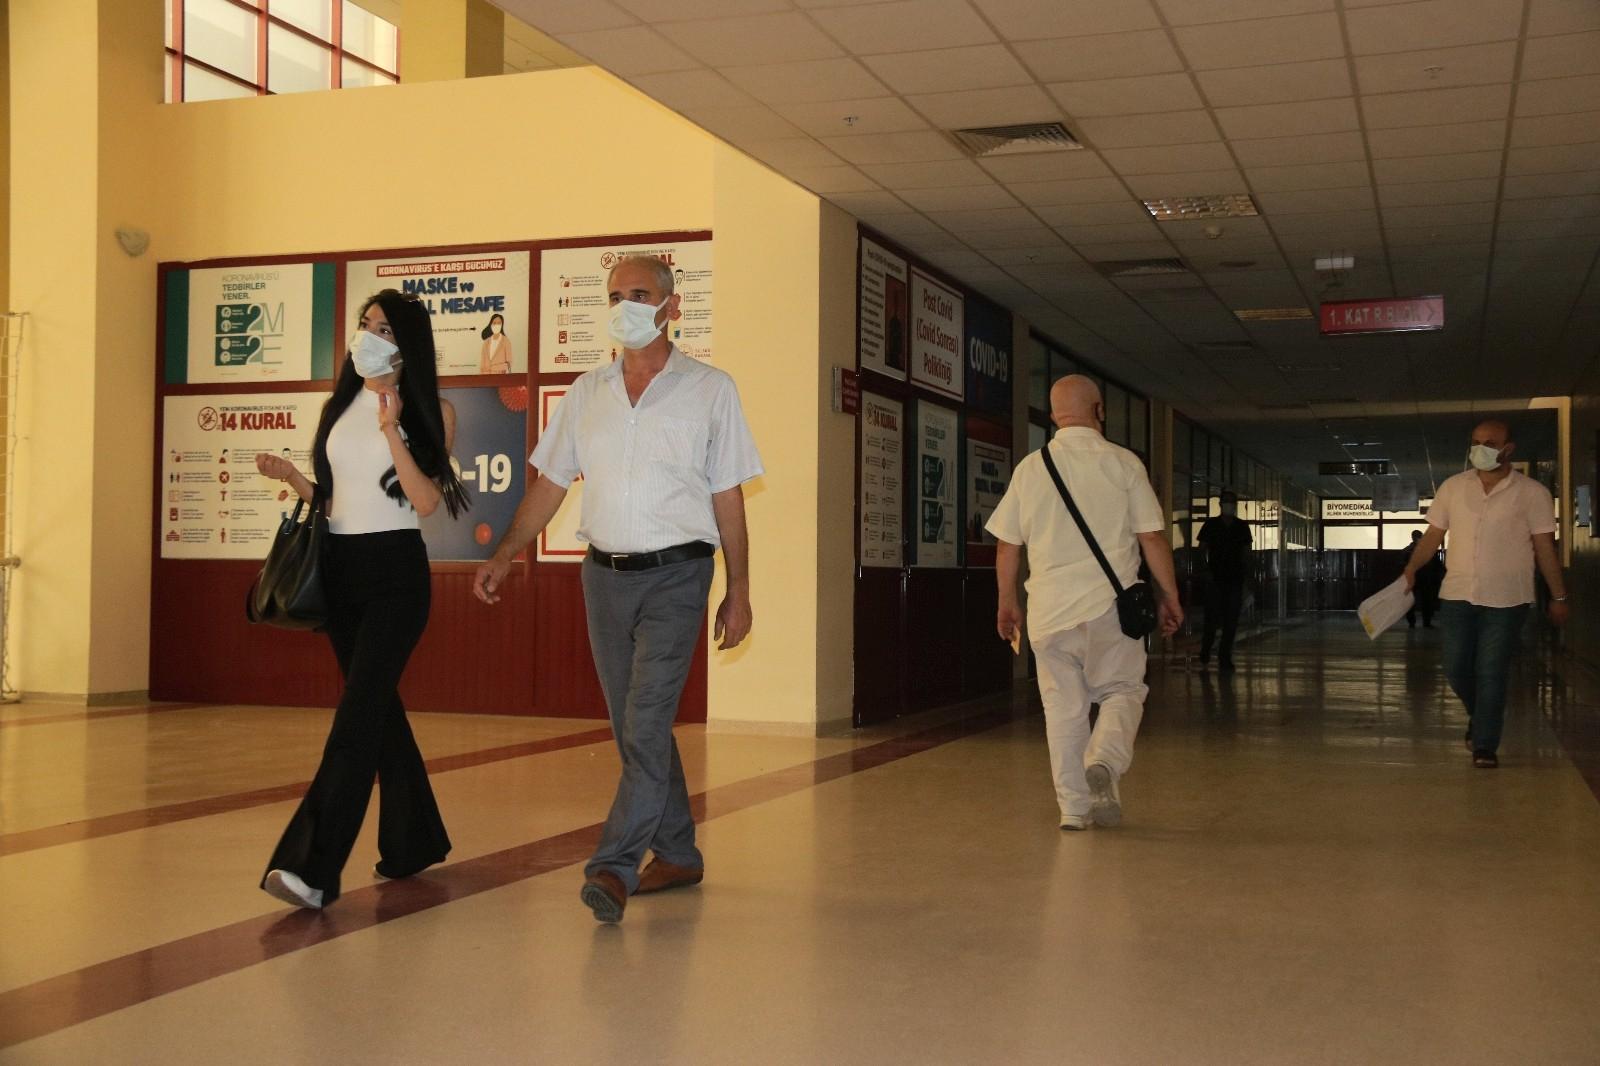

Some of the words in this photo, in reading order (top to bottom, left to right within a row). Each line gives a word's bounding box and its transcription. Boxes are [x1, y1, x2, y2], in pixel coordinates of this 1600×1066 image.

[440, 261, 464, 273] KARŞI
[222, 282, 266, 291] TEDBİRLER
[402, 276, 458, 295] MASKE
[440, 296, 505, 314] MESAFE
[923, 287, 937, 314] Post
[937, 294, 953, 322] Covid
[1344, 307, 1369, 325] KAT
[969, 336, 1008, 383] COVID-19
[219, 412, 237, 431] 14
[240, 411, 297, 430] KURAL
